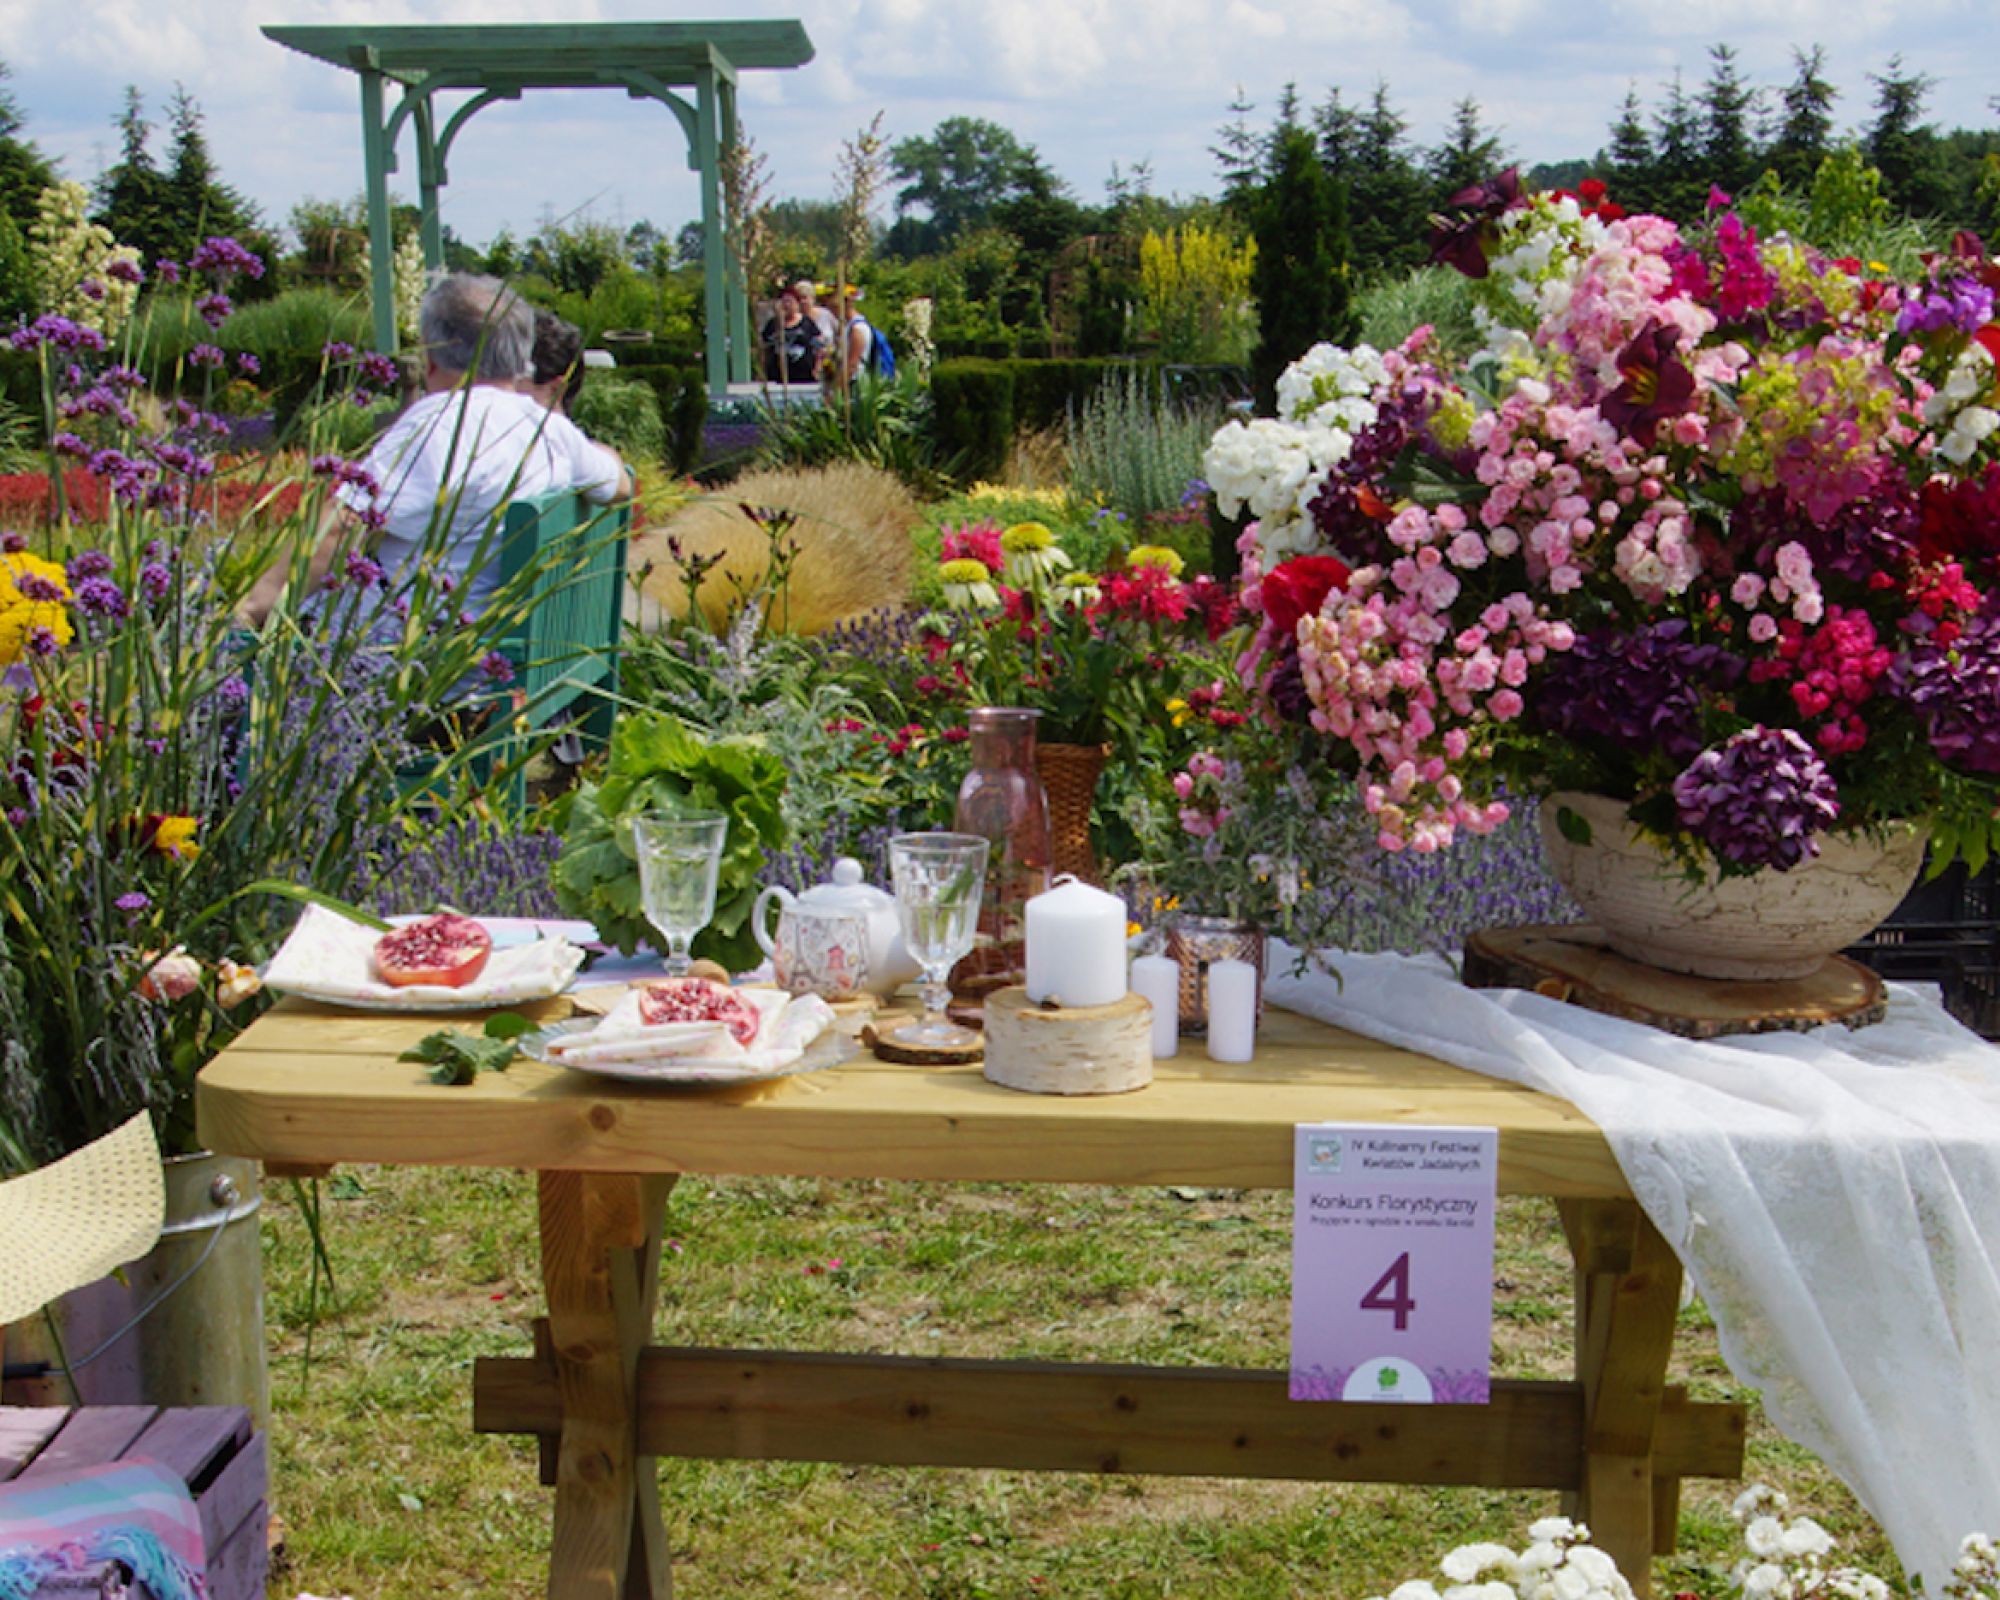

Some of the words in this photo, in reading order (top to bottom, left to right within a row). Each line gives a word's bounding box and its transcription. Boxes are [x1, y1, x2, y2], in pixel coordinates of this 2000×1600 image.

[1351, 1140, 1364, 1151] IV
[1368, 1140, 1425, 1155] Kulinarny
[1431, 1141, 1481, 1154] Festiwal
[1362, 1158, 1415, 1169] Kwiatów
[1419, 1158, 1480, 1173] Jadalnych
[1310, 1194, 1372, 1210] Konkurs
[1378, 1195, 1478, 1215] Florystyczny
[1360, 1252, 1415, 1331] 4
